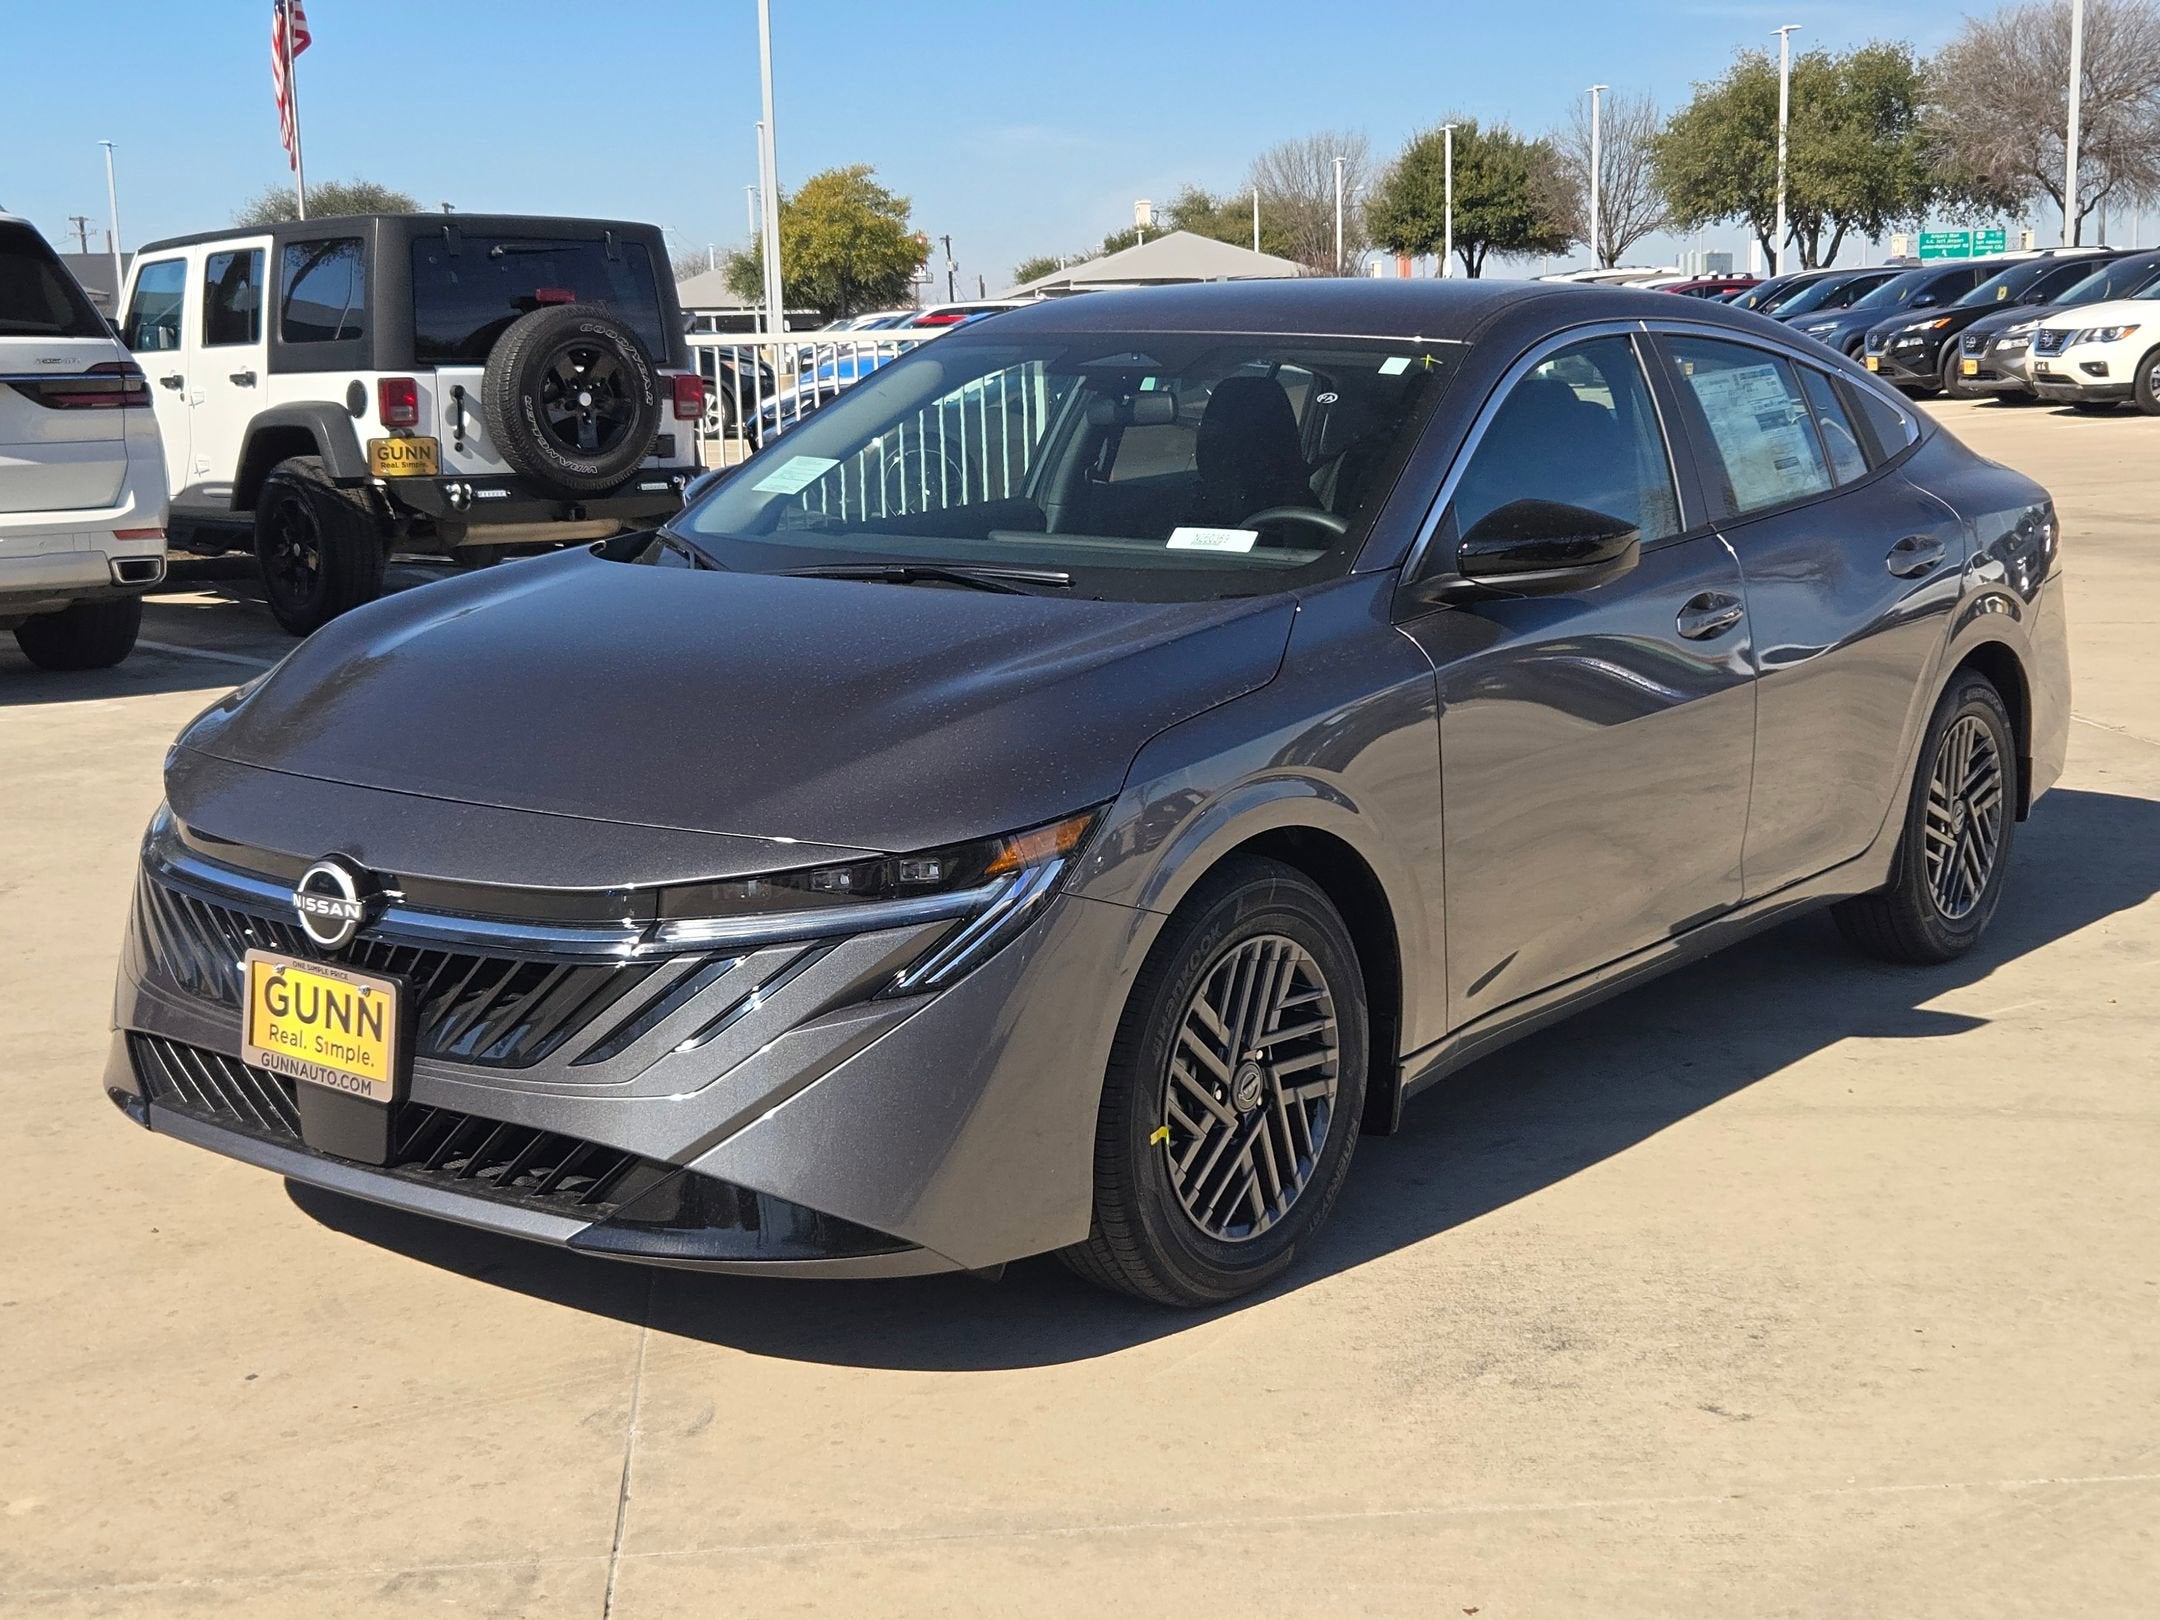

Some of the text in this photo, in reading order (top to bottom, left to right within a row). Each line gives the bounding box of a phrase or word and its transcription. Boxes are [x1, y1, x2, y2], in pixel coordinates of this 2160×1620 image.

[579, 322, 656, 408] GOODYEAR
[377, 446, 432, 460] GUNN
[523, 395, 599, 475] WRANGLER
[293, 893, 360, 920] NISSAN
[264, 975, 383, 1043] GUNN
[269, 1022, 308, 1050] Real.
[261, 1051, 372, 1097] GUNNAUTO.COM
